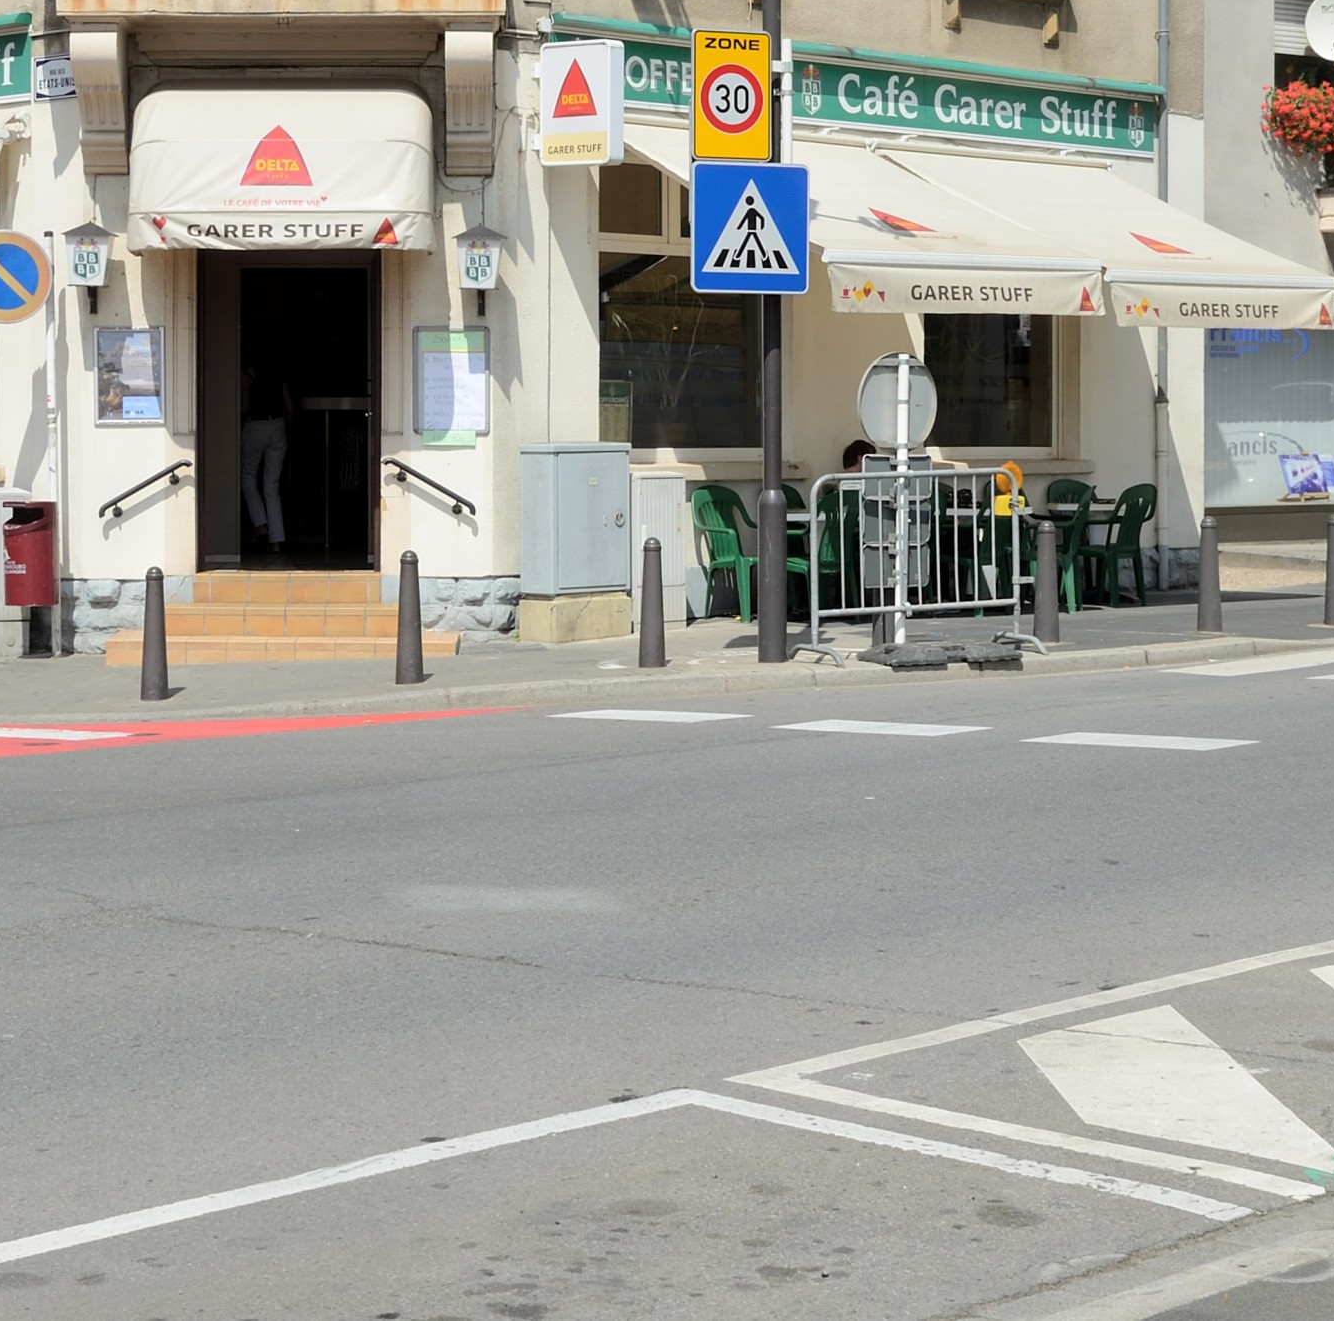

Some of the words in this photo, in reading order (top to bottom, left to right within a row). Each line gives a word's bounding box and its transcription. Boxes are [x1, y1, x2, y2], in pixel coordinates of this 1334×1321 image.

[705, 37, 760, 51] ZONE
[561, 93, 589, 105] DELTA
[715, 83, 749, 114] 30
[838, 73, 919, 119] Café
[934, 84, 1027, 130] Garer
[1040, 95, 1117, 140] Stuff
[547, 145, 575, 155] GARER
[577, 143, 602, 154] STUFF
[255, 159, 300, 171] DELTA
[186, 224, 273, 239] GARER
[283, 223, 364, 238] STUFF
[910, 284, 974, 301] GARER
[980, 286, 1033, 302] STUFF
[1179, 302, 1230, 318] GARER
[1235, 303, 1279, 319] STUFF
